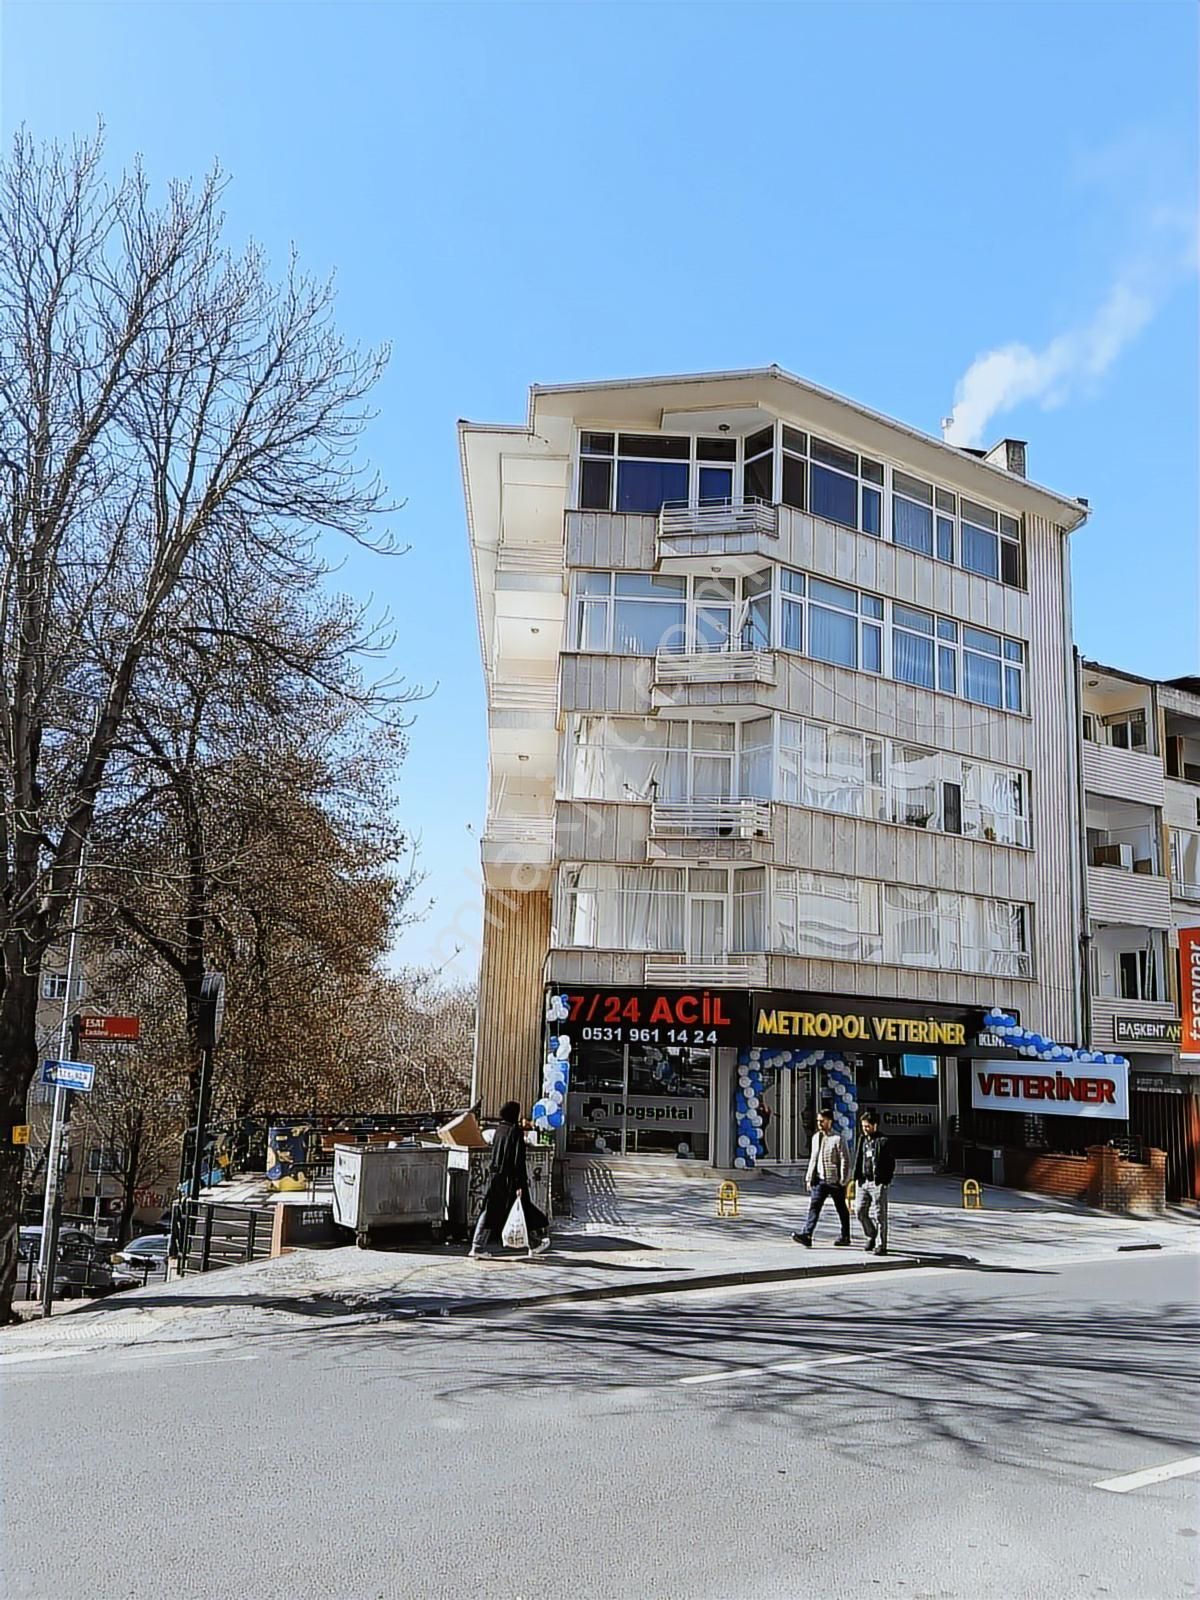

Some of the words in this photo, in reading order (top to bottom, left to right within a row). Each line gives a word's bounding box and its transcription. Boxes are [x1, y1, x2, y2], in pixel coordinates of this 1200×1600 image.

[569, 994, 641, 1023] 7/24
[650, 991, 731, 1025] ACİL
[582, 1027, 622, 1042] 0531
[629, 1028, 660, 1043] 961
[667, 1029, 688, 1044] 14
[693, 1030, 718, 1044] 24
[756, 1009, 870, 1040] METROPOL
[872, 1016, 966, 1046] VETERİNER
[1118, 1022, 1165, 1040] BAŞKENT
[977, 1069, 1117, 1105] VETERİNER
[613, 1102, 694, 1120] Dogspital
[883, 1111, 932, 1126] Catspital
